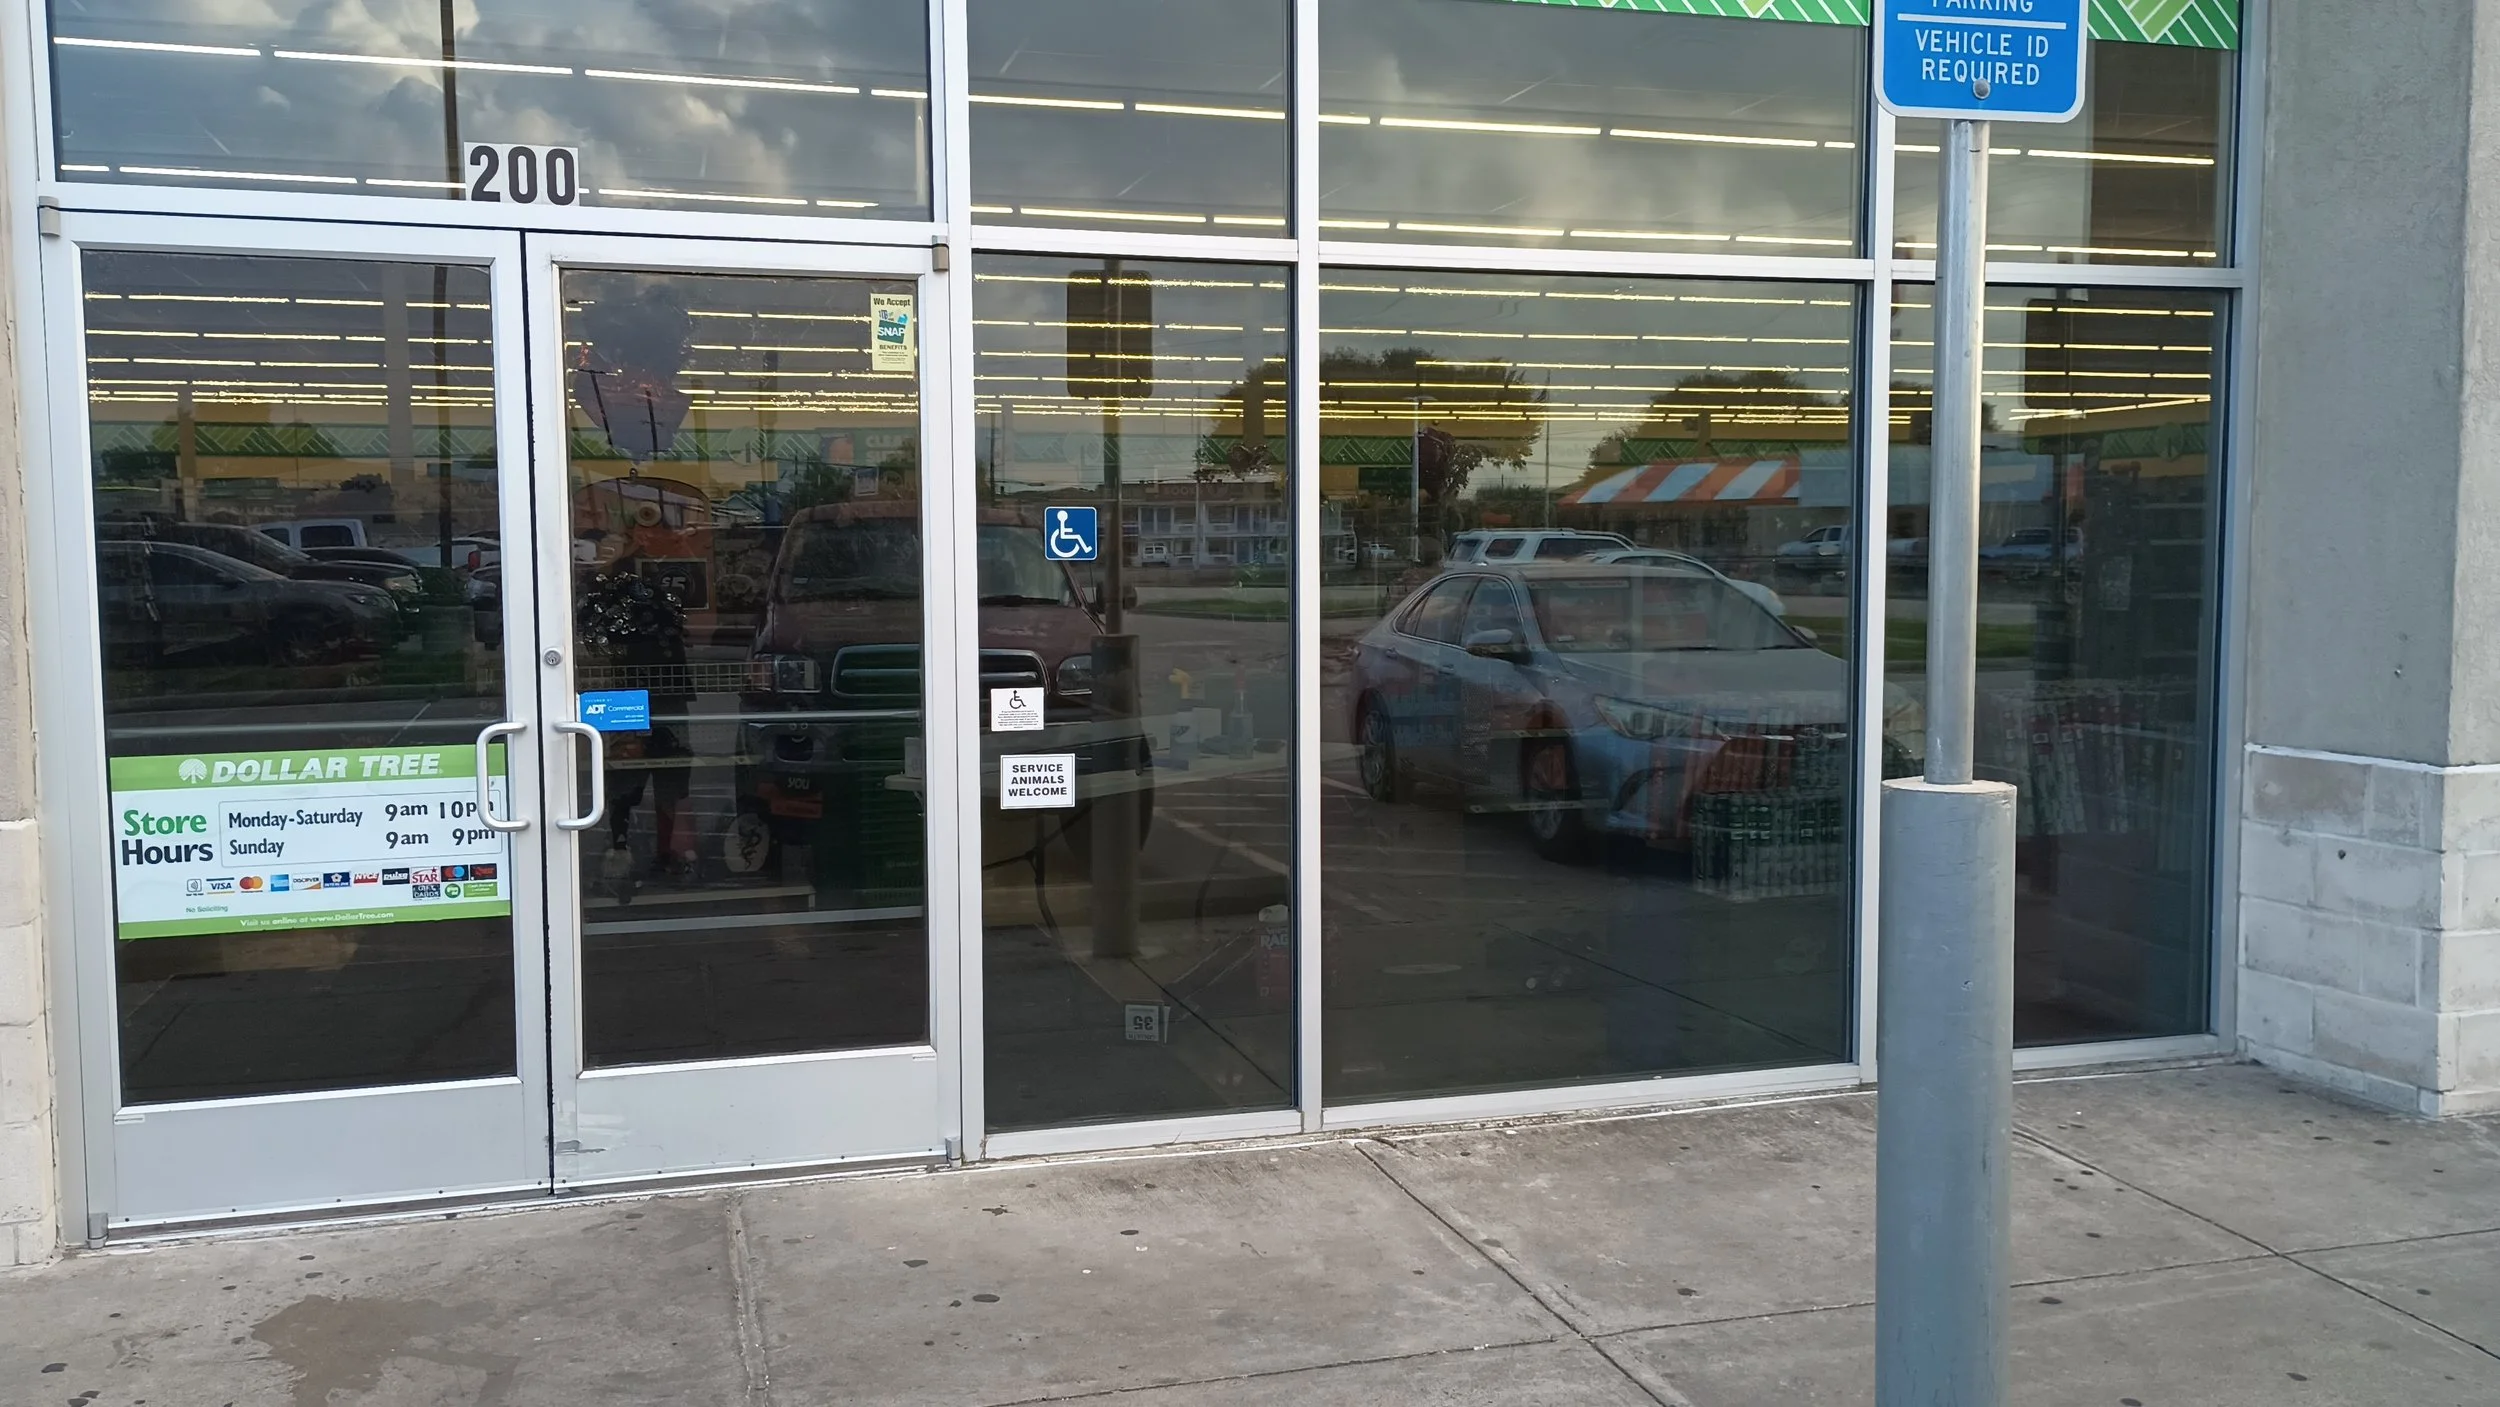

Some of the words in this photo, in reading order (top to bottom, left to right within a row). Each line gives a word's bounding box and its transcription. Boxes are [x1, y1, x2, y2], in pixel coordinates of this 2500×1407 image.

[1915, 29, 2012, 55] VEHICLE
[2028, 35, 2049, 58] ID
[1922, 58, 2040, 85] REQUIRED
[470, 145, 576, 205] 200
[873, 297, 885, 306] We
[887, 298, 911, 307] Accept
[878, 326, 905, 337] SNAP
[586, 704, 606, 714] ADT
[211, 757, 348, 784] DOLLAR
[359, 753, 441, 777] TREE
[1012, 763, 1063, 773] SERVICE
[1011, 775, 1064, 785] ANIMALS
[1008, 787, 1067, 797] WELCOME
[123, 809, 207, 836] Store
[228, 808, 363, 830] Monday-Saturday
[121, 839, 213, 866] Hours
[230, 838, 285, 857] Sunday
[355, 872, 379, 880] NYCE
[412, 873, 439, 884] STAR
[210, 882, 232, 890] VISA
[197, 904, 229, 913] Soliciting
